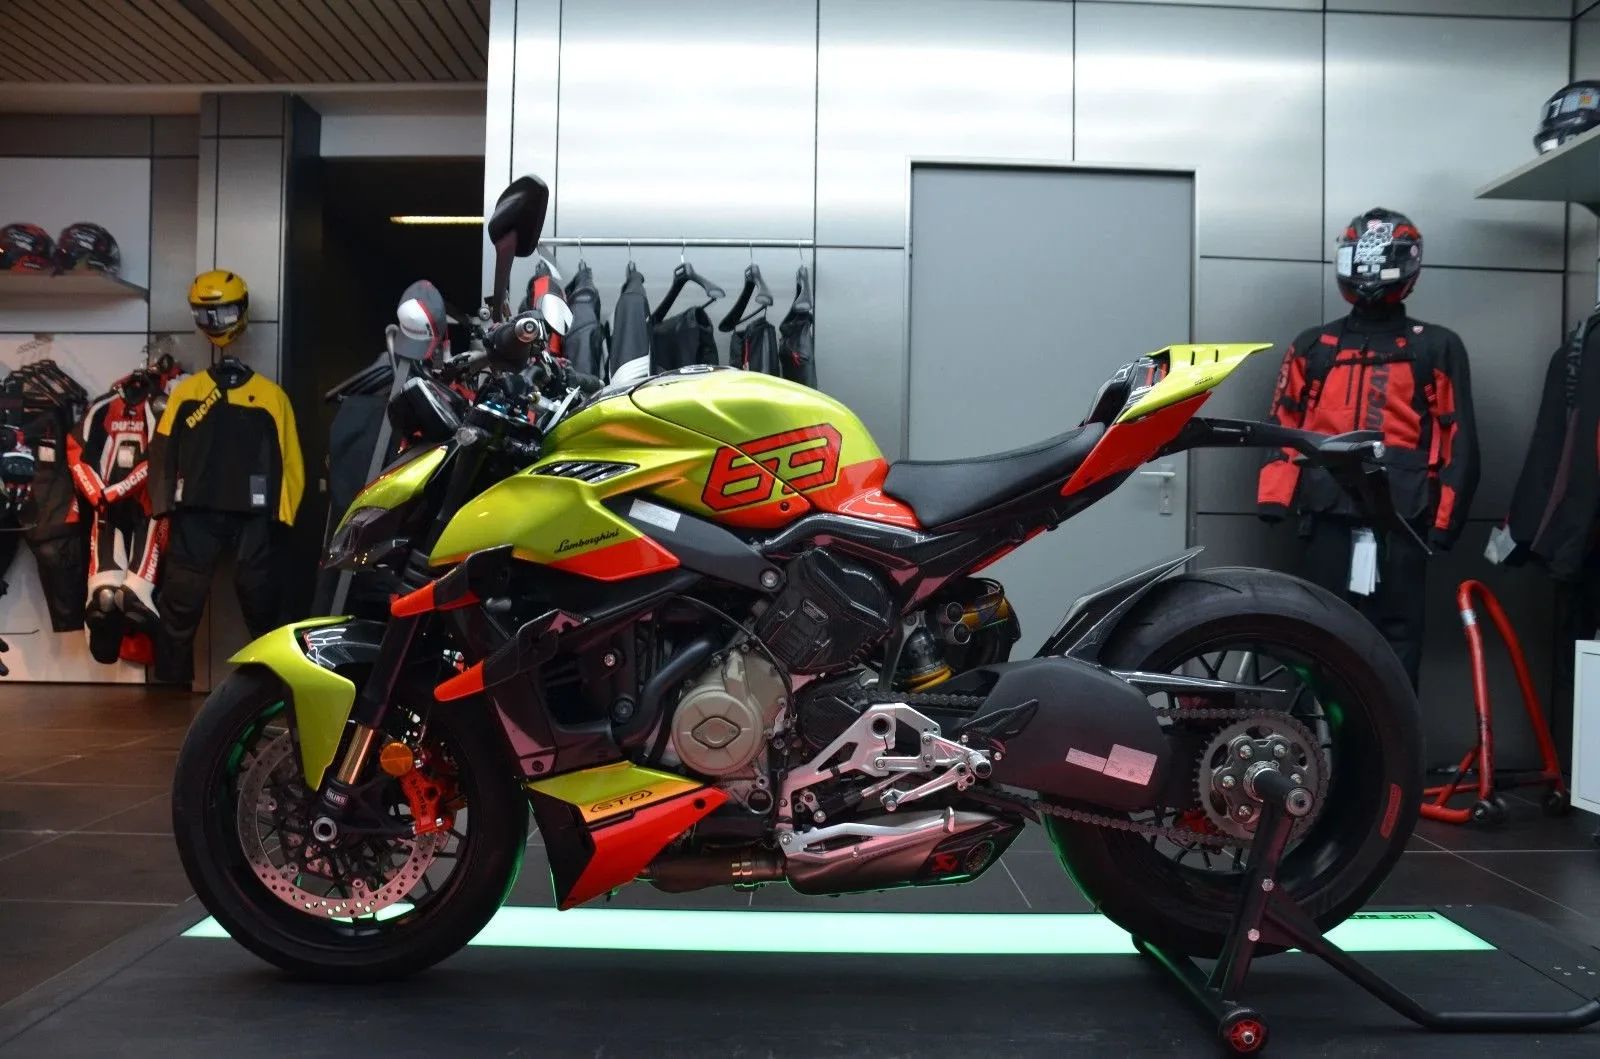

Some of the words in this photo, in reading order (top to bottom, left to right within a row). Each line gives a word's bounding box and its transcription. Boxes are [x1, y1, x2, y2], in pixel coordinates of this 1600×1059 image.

[185, 386, 222, 429] DUCATI
[1366, 363, 1391, 429] UCAT
[116, 464, 149, 497] DUCAT
[554, 528, 619, 554] Lamborghini
[596, 792, 647, 811] STO
